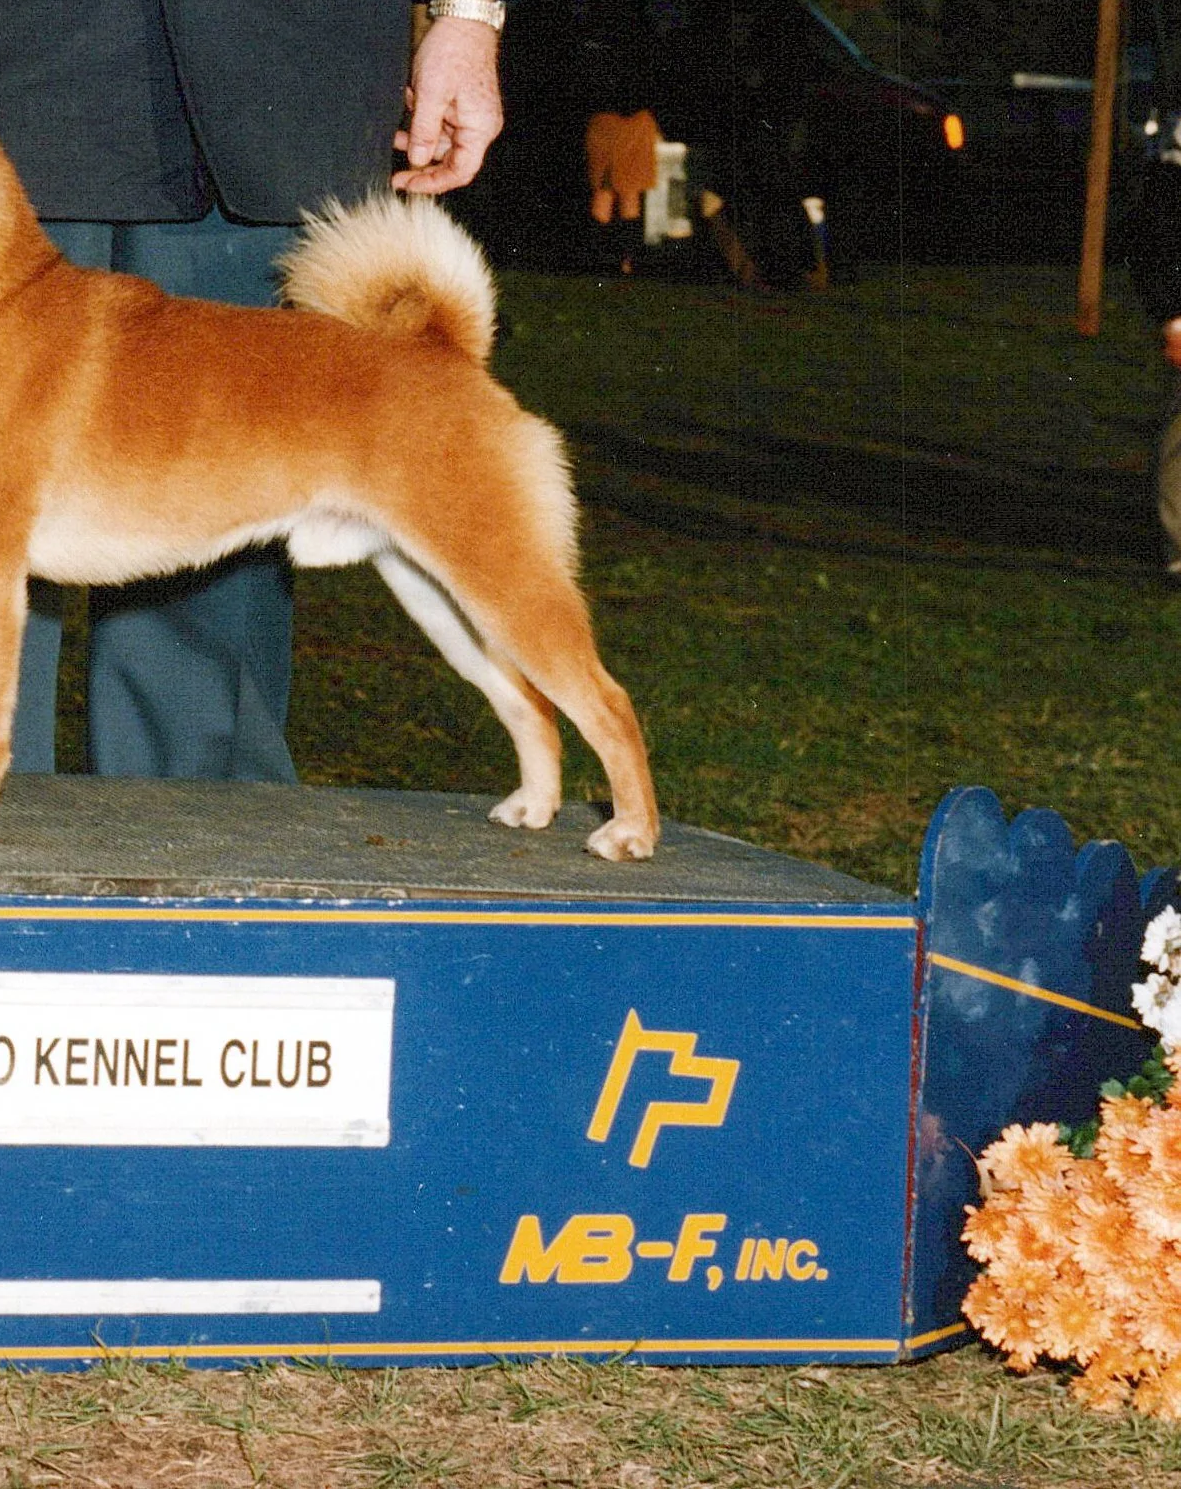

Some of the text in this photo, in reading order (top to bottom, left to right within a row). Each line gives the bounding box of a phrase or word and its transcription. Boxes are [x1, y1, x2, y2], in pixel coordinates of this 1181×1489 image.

[35, 1037, 203, 1087] KENNEL
[220, 1039, 332, 1089] CLUB
[500, 1214, 827, 1290] MB-F, INC.
